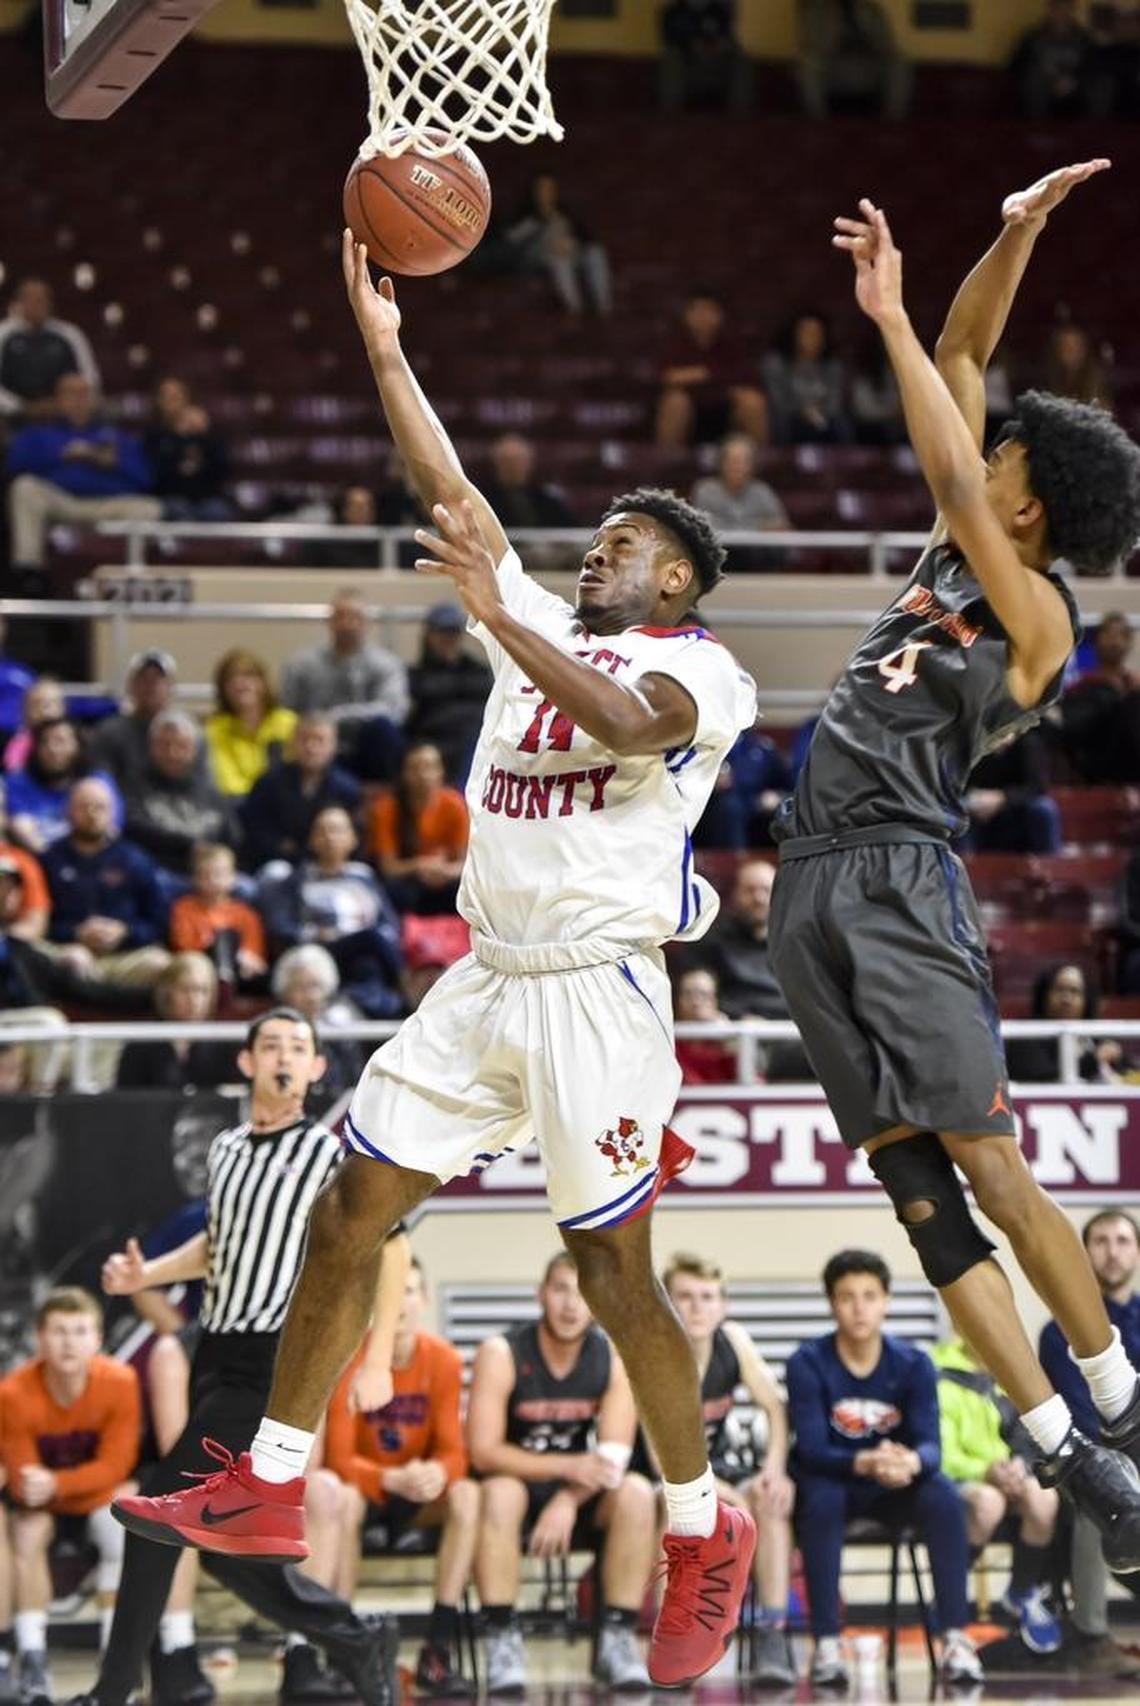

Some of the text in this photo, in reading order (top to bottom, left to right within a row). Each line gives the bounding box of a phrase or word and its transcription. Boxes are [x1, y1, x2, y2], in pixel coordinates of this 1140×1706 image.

[409, 164, 442, 192] TF
[877, 641, 932, 694] 4
[482, 763, 617, 819] OUNTY
